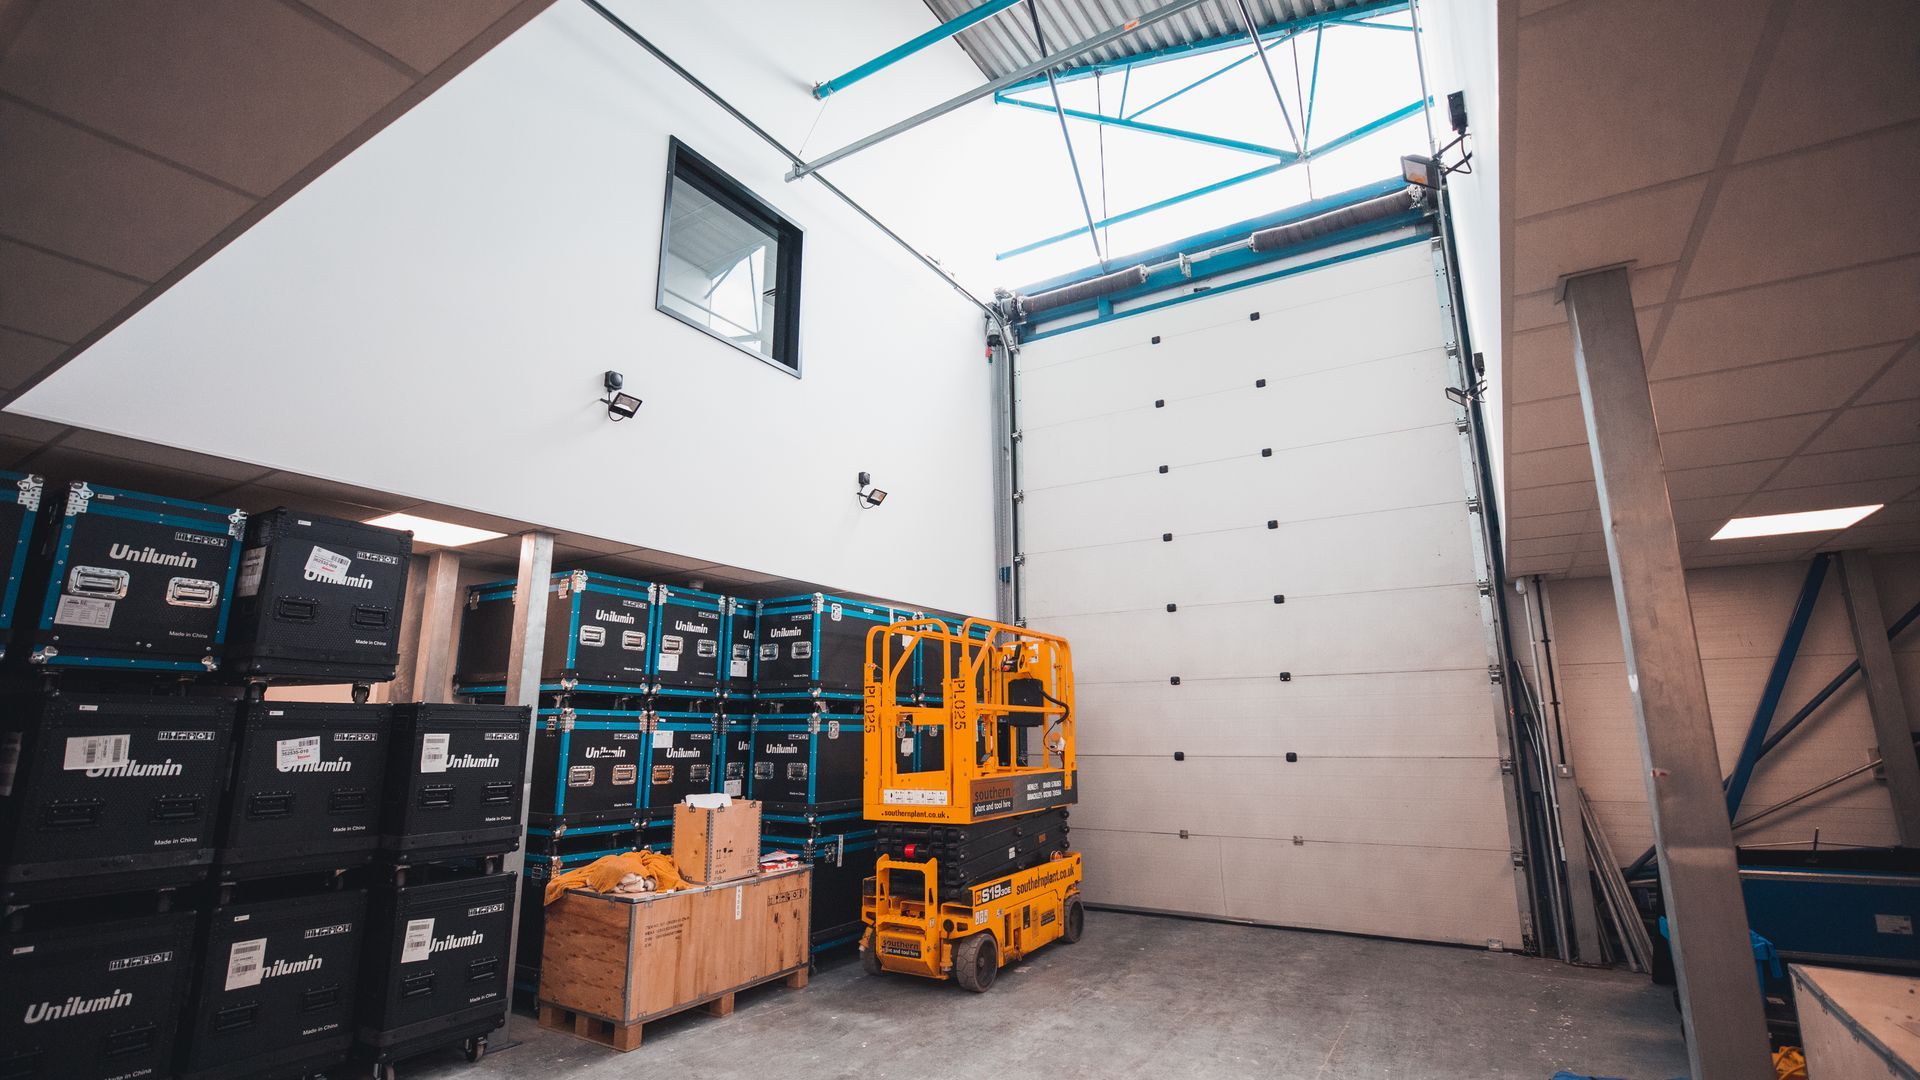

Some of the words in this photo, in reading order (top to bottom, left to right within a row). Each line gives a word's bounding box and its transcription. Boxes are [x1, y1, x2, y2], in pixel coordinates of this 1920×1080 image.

[109, 543, 198, 568] Unilumin
[595, 609, 635, 625] Unilumin
[675, 620, 709, 634] Unilumin
[770, 626, 802, 638] Unilumin
[666, 747, 701, 759] Unilumin
[766, 743, 798, 754] Unilumin
[974, 787, 1011, 801] southern
[974, 803, 986, 816] plant
[986, 803, 994, 811] and
[994, 800, 1003, 809] tool
[1003, 800, 1011, 808] hire
[1016, 864, 1075, 895] southernplant.co.uk
[24, 989, 132, 1024] Unilumin
